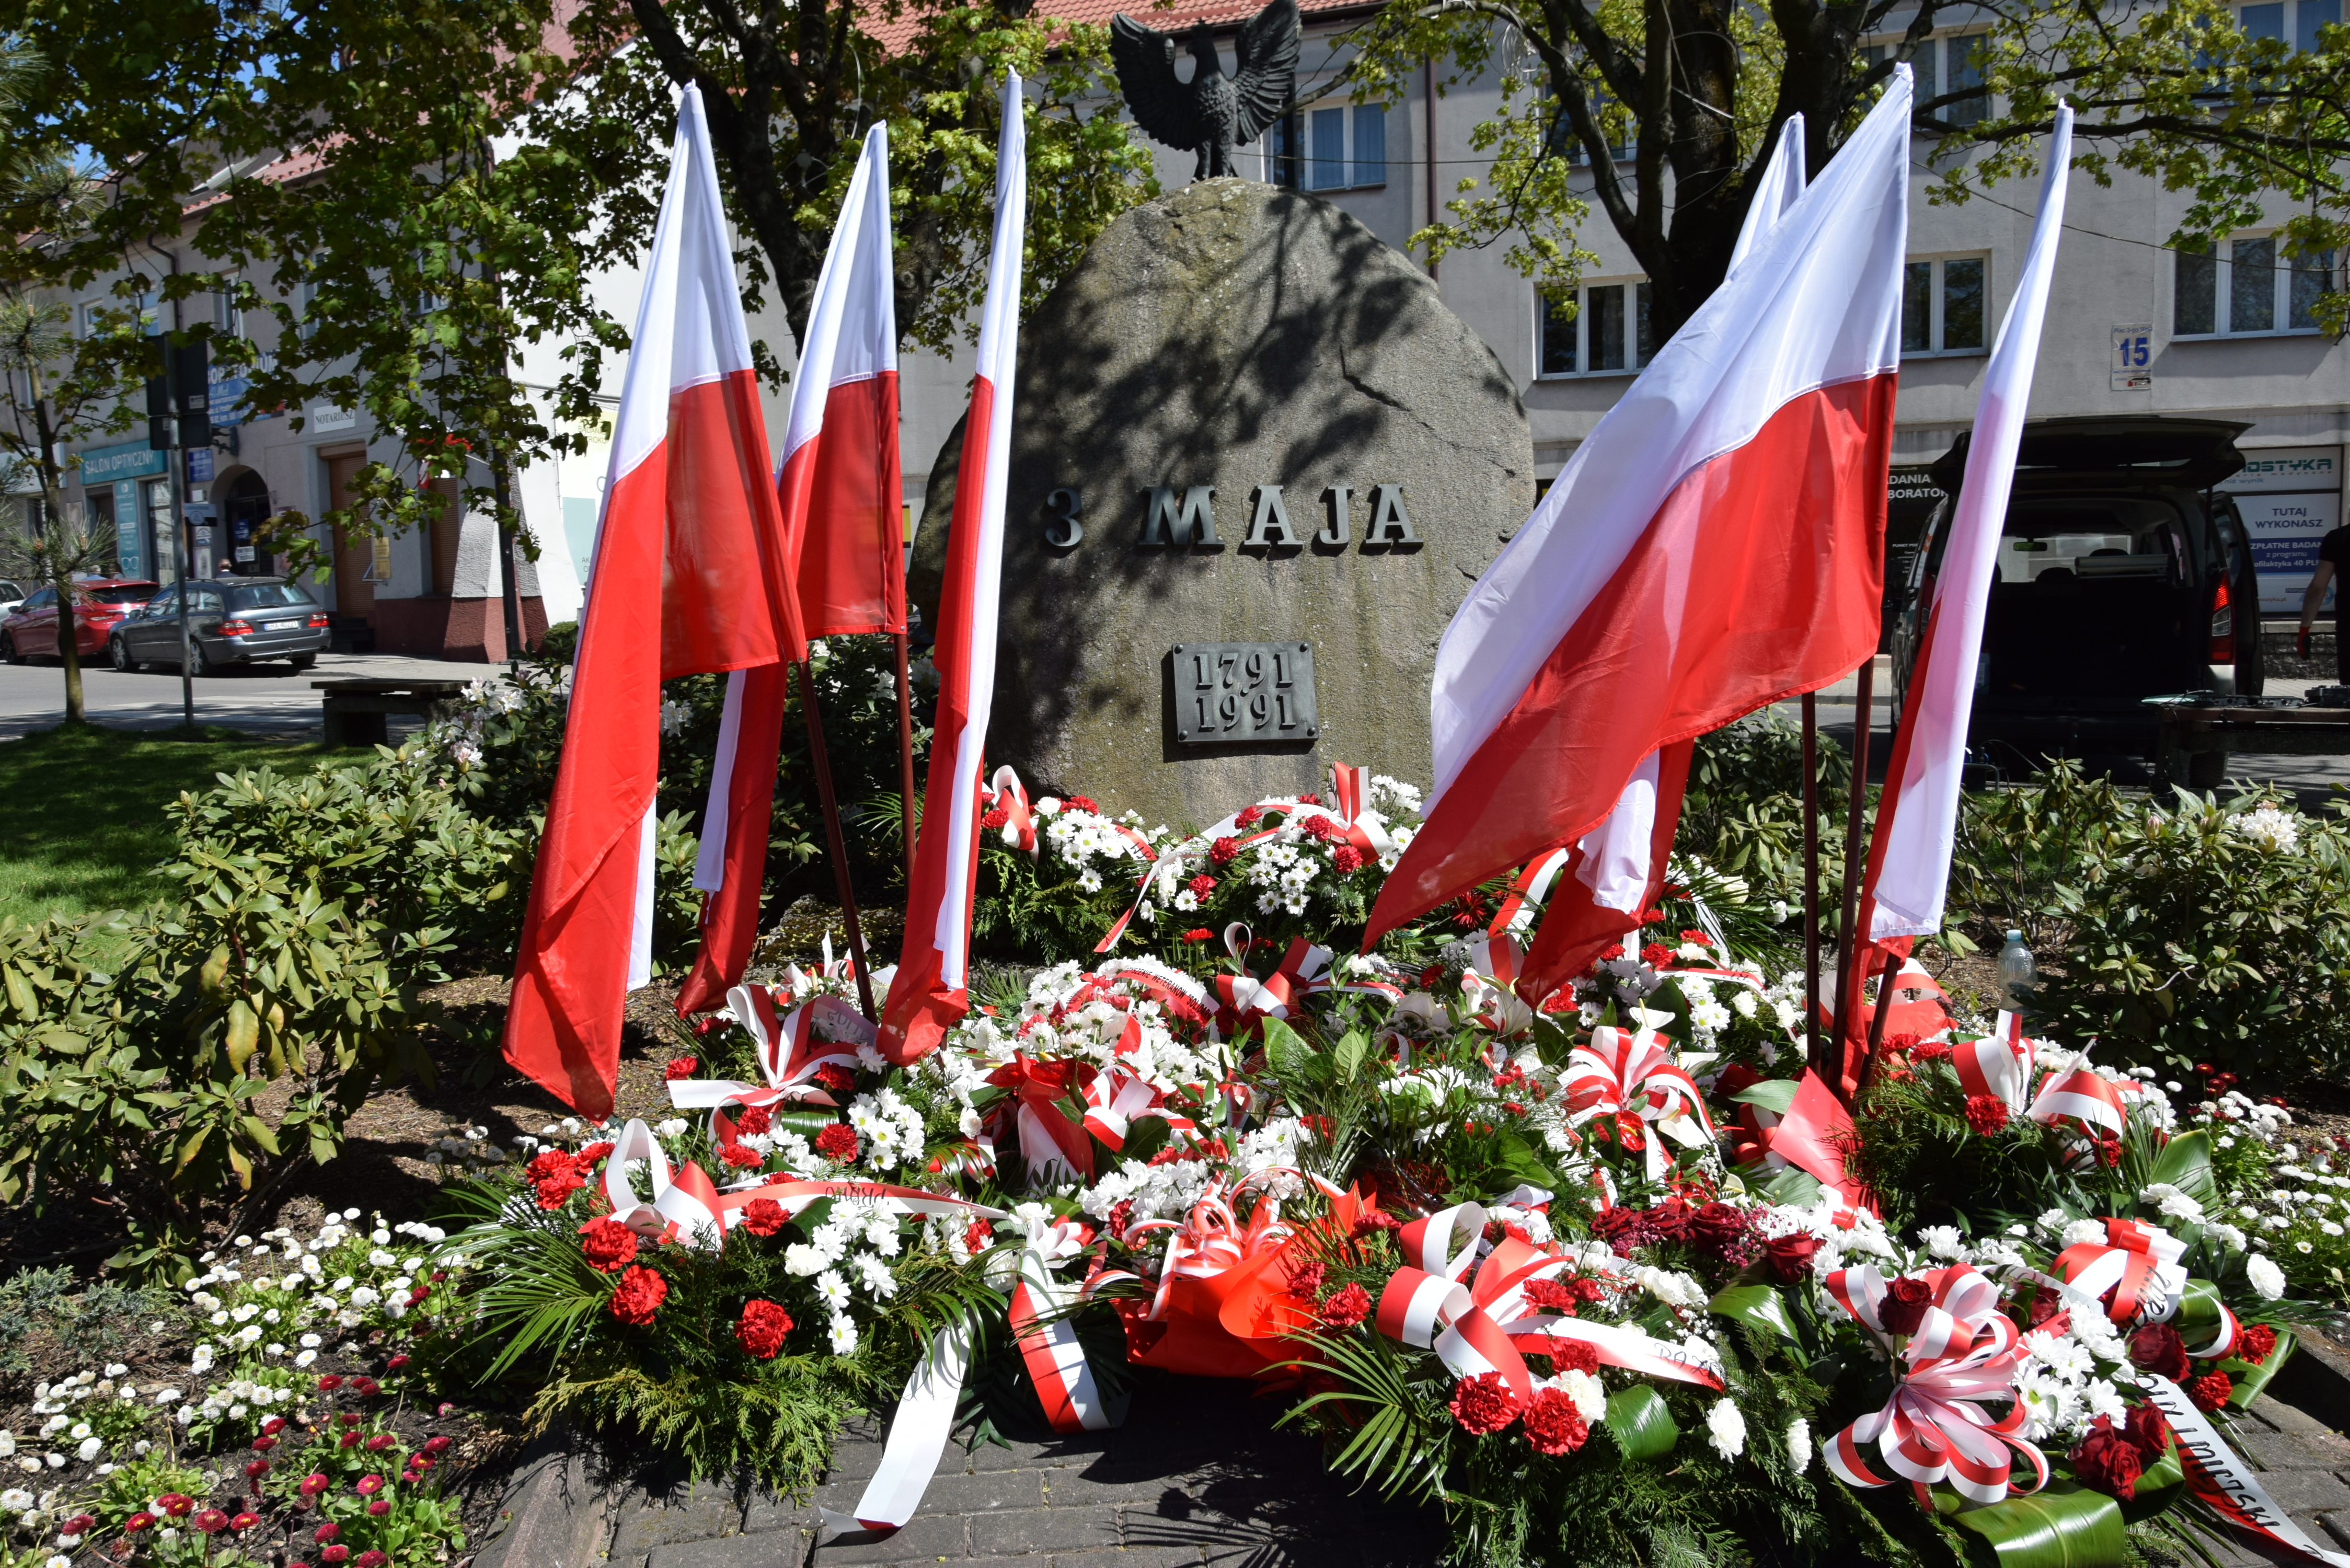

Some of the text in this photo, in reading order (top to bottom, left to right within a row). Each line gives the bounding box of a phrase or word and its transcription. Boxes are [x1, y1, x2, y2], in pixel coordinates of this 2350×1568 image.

[2119, 337, 2149, 366] 15
[315, 410, 354, 425] NOTARIUSZ
[85, 449, 154, 475] SALON OPTYCZNY
[1887, 474, 1931, 484] DANIA
[1044, 483, 1424, 550] 3 MAJA
[2255, 519, 2323, 528] WYKONASZ
[2272, 508, 2307, 517] TUTAJ
[1193, 650, 1294, 690] 1791
[1196, 694, 1297, 733] 1991
[1124, 967, 1153, 978] ZYSZENIE
[1151, 973, 1188, 1000] WETERANÓW
[2175, 1440, 2280, 1527] MIEJSKI
